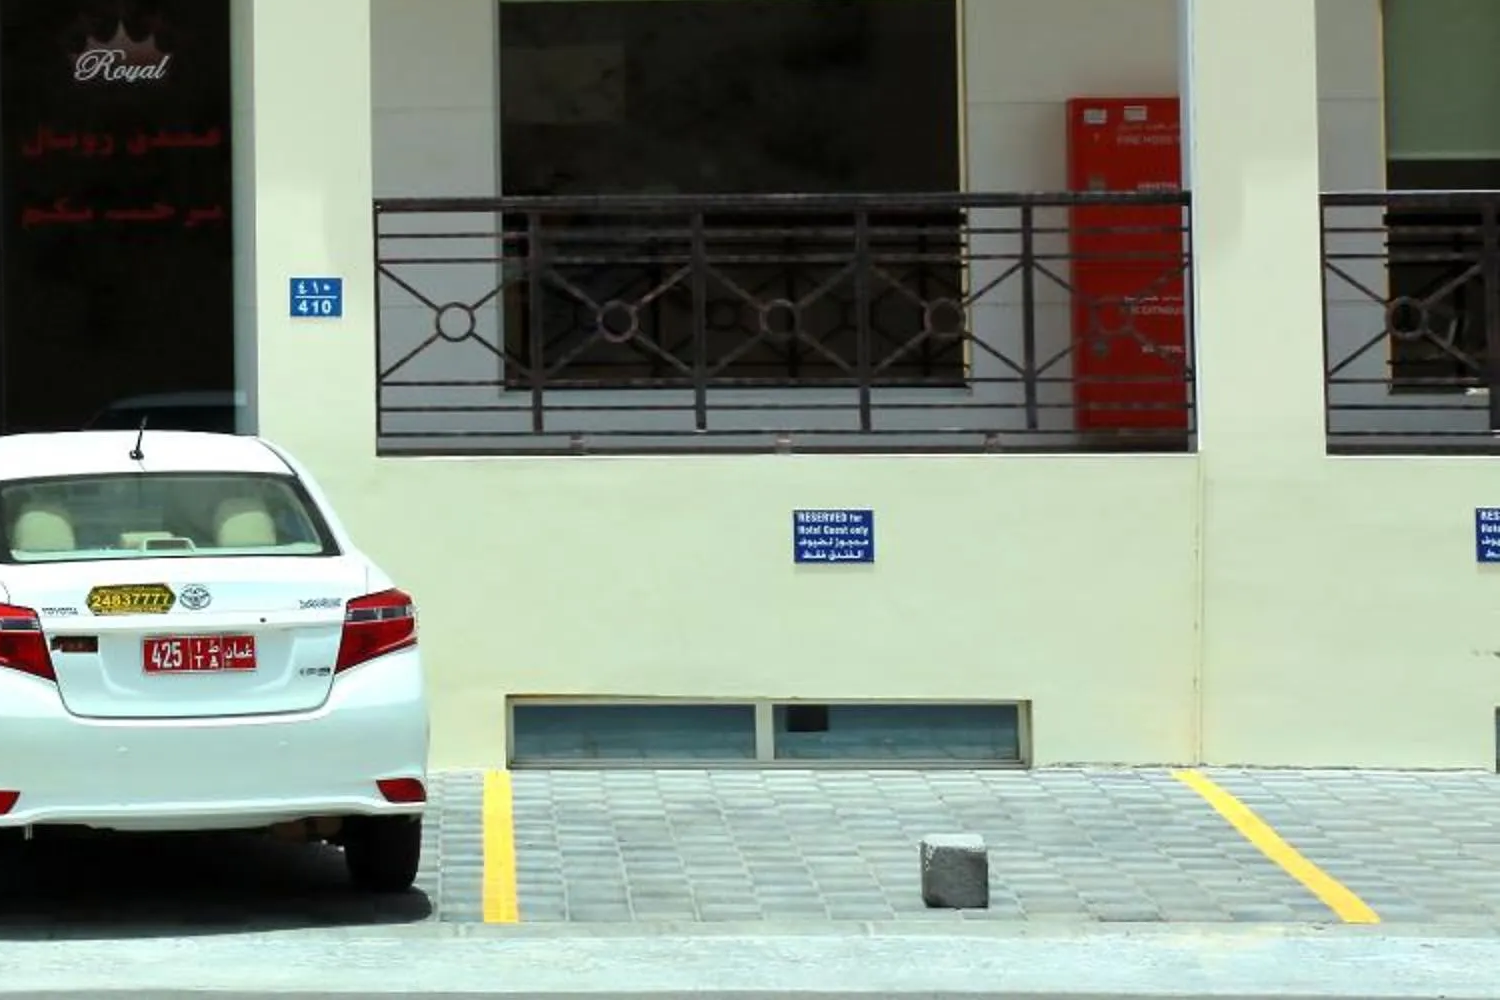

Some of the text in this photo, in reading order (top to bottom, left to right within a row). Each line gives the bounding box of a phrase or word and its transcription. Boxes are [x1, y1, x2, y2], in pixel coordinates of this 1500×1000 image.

[73, 48, 172, 83] Royal
[298, 299, 332, 315] 410
[151, 641, 183, 669] 425
